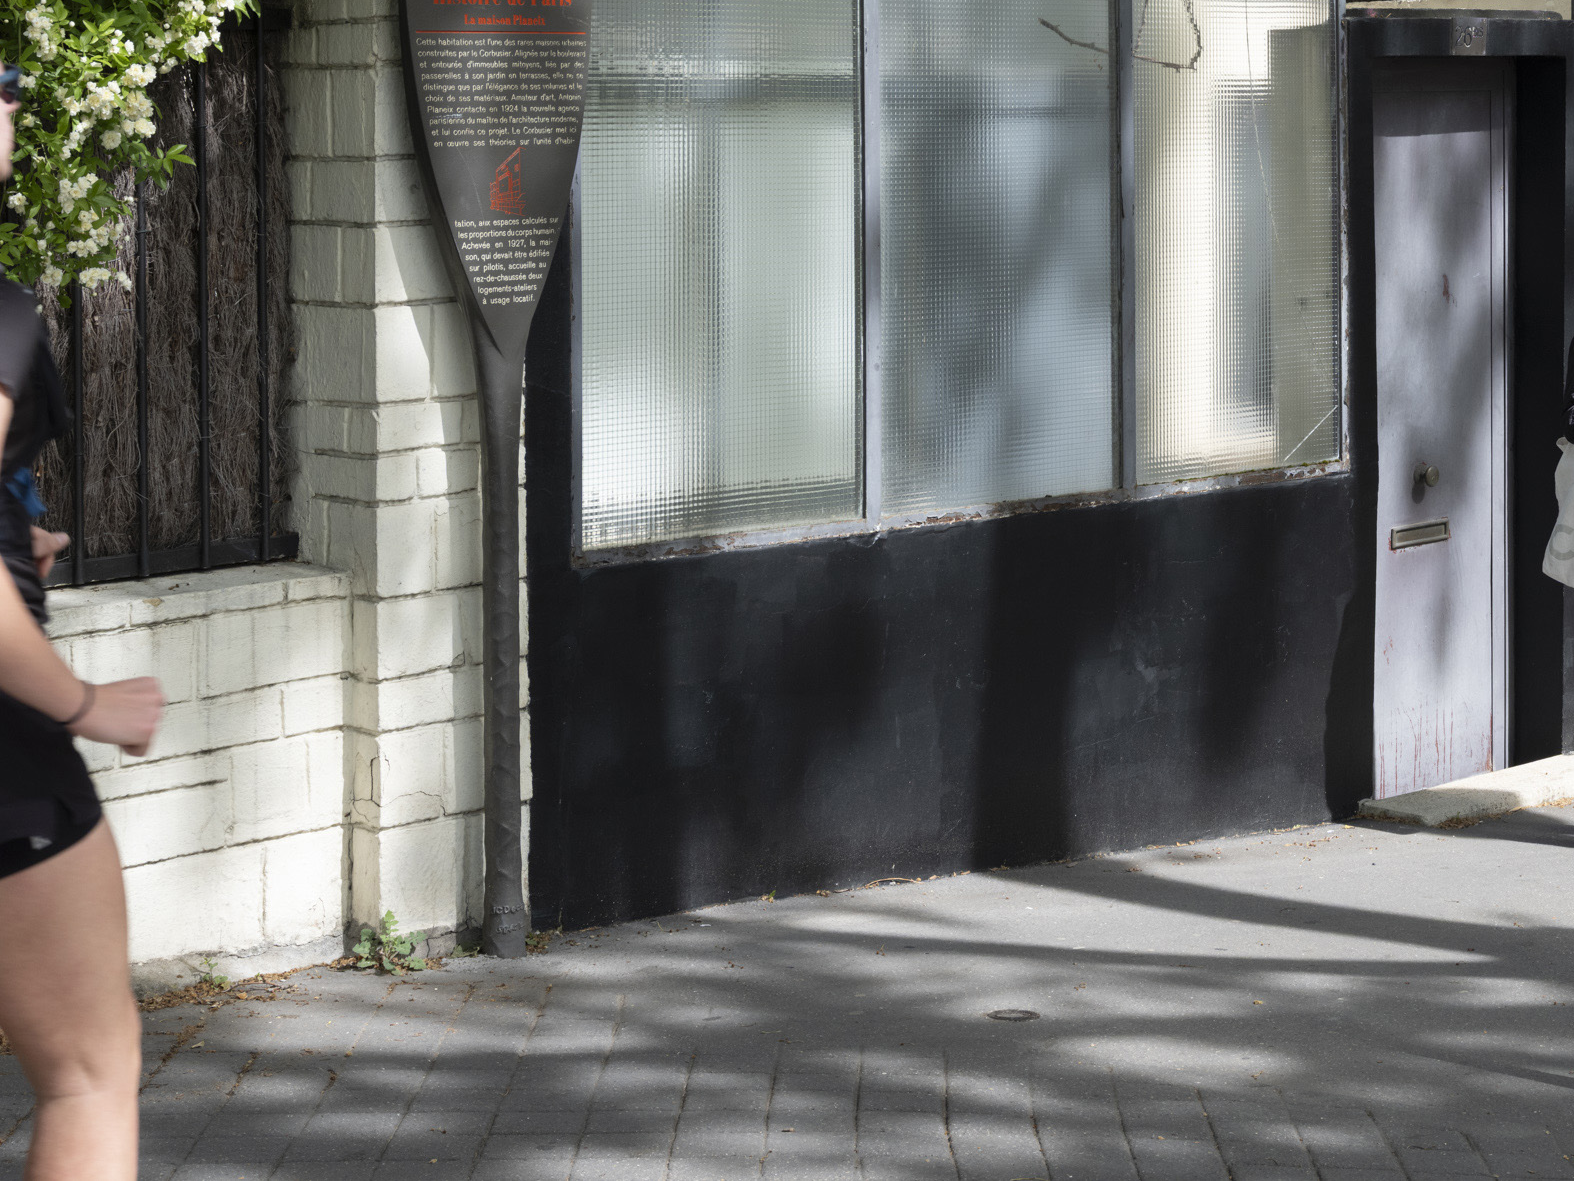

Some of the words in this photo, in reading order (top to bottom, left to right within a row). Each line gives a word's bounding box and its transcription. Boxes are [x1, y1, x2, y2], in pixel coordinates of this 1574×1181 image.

[464, 14, 477, 25] La
[478, 14, 511, 25] maison
[513, 15, 546, 25] Planeix
[438, 38, 473, 46] habitation
[475, 38, 485, 46] est
[418, 49, 456, 57] construites
[458, 51, 469, 59] par
[471, 49, 478, 57] le
[421, 72, 461, 81] passerelles
[487, 72, 506, 81] jardin
[519, 72, 551, 81] terrasses,
[423, 83, 455, 92] distingue
[425, 94, 443, 102] choix
[456, 105, 486, 113] contacte
[551, 116, 578, 125] moderne,
[488, 128, 509, 136] projet.
[455, 220, 476, 228] tation,
[469, 230, 506, 239] proportions
[508, 241, 526, 249] 1927,
[481, 253, 491, 261] qui
[483, 263, 506, 272] pilotis,
[477, 284, 537, 294] logements-ateliers
[490, 298, 510, 306] usage
[513, 295, 535, 303] locatif.
